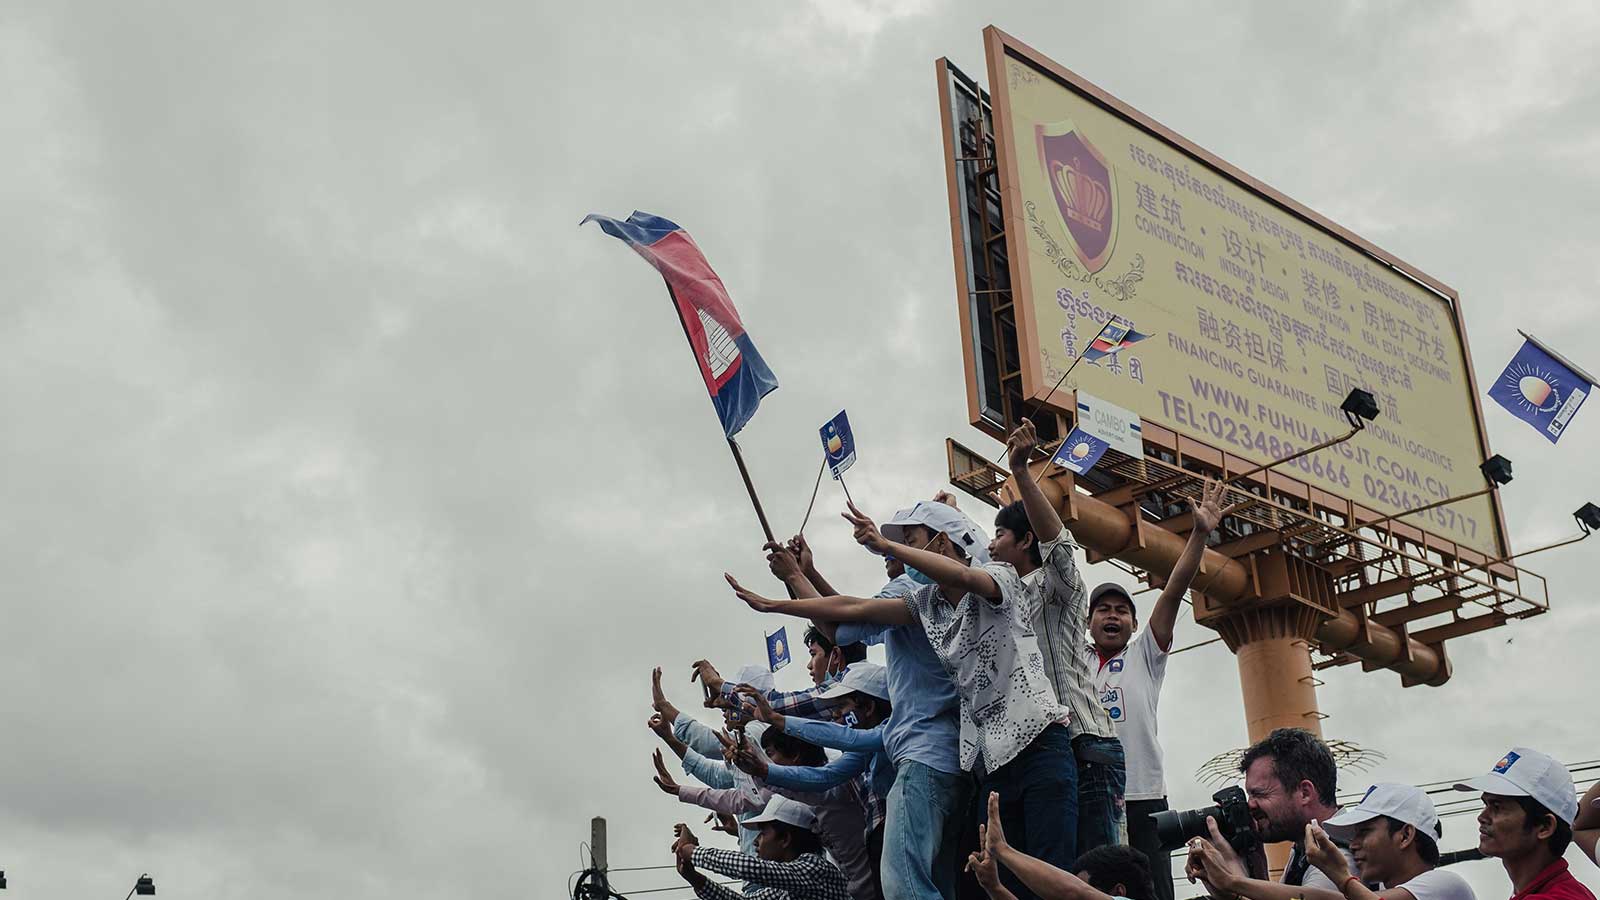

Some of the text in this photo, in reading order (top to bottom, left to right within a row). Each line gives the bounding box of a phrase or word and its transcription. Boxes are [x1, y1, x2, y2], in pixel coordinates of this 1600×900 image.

[1134, 181, 1449, 366] 建筑 设计 装修 房地产开发
[1135, 214, 1205, 261] CONSTRUCTION
[1219, 256, 1256, 287] INTERIOR
[1260, 276, 1290, 303] DESIGN
[1061, 328, 1144, 385] 富集团
[1168, 331, 1244, 378] FINANCING
[1248, 368, 1317, 410] GUARANTEE
[1196, 305, 1289, 373] 融资担保
[1094, 409, 1126, 434] CAMBO
